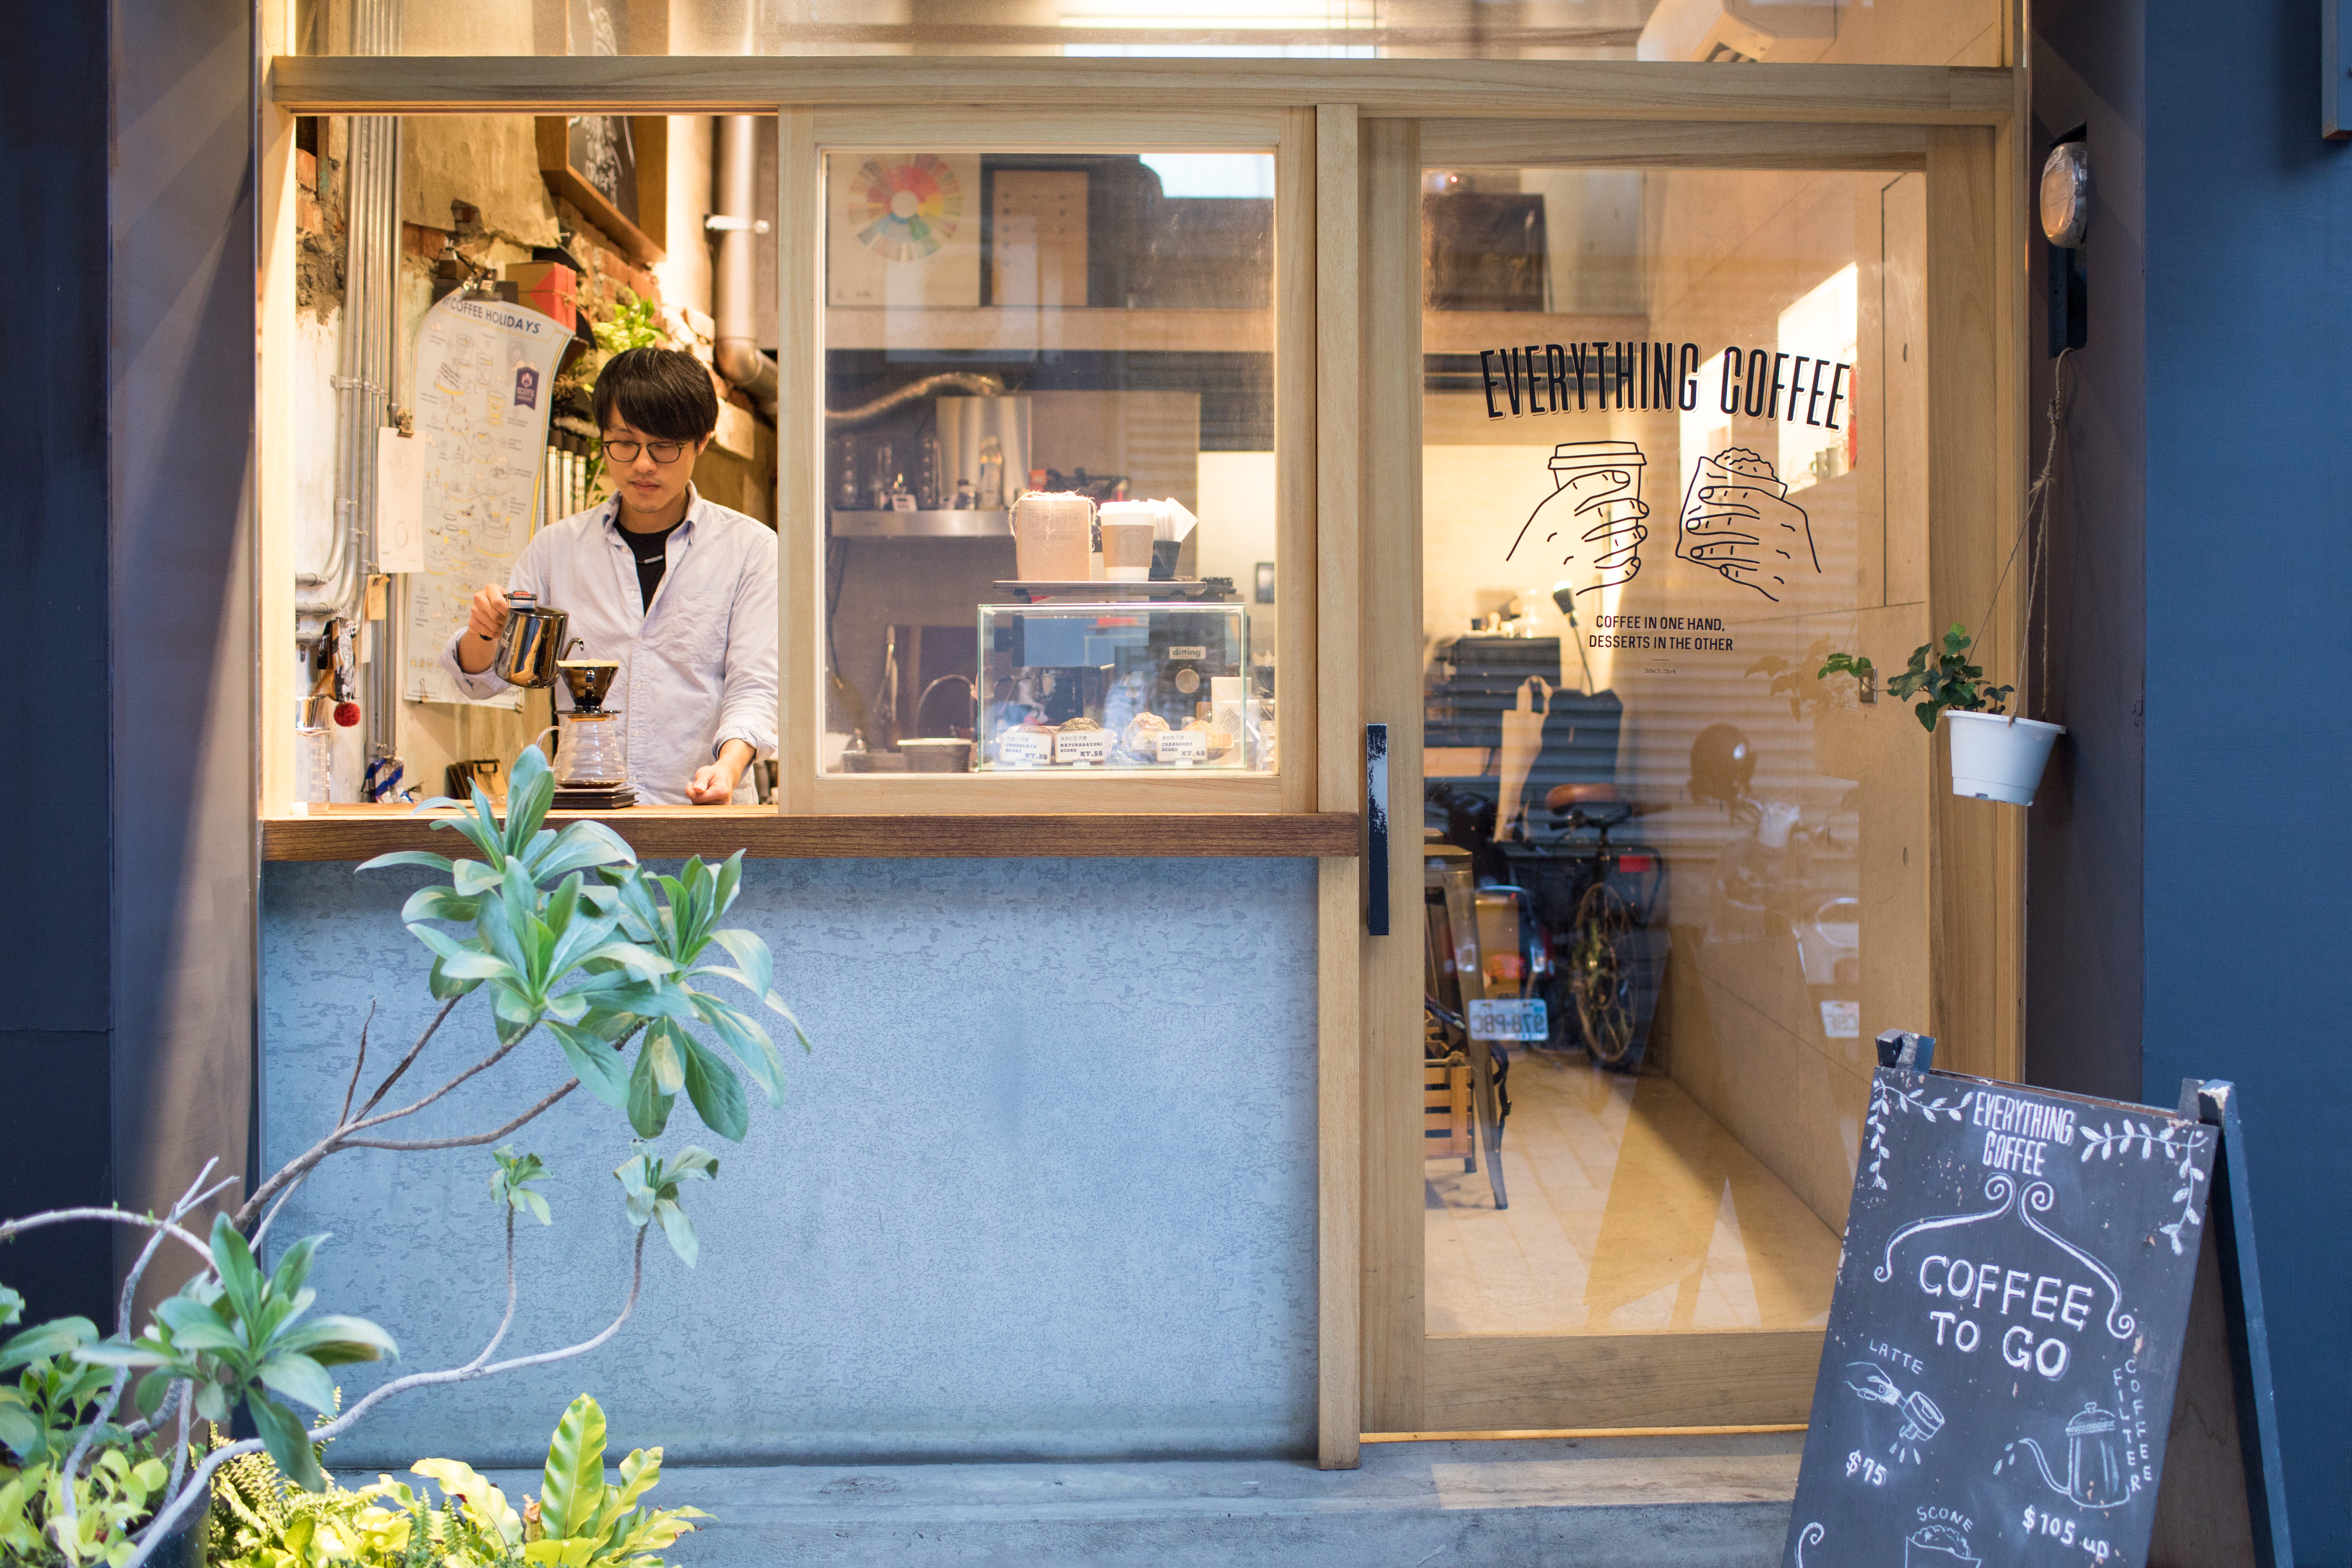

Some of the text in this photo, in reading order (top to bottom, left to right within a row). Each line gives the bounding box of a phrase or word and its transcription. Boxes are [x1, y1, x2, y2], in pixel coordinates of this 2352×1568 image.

[451, 298, 482, 318] COFFEE
[486, 309, 540, 334] HOLIDAYS
[1480, 341, 1853, 433] EVERYTHING COFFEE
[1589, 635, 1733, 651] DESSERTS IN THE OTHER
[1596, 615, 1725, 632] COFFEE IN ONE HAND,
[1173, 648, 1201, 657] ditting
[1973, 1091, 2076, 1146] EVERYTHING
[1982, 1130, 2047, 1177] COFFEE
[1919, 1255, 2095, 1332] COFFEE
[1869, 1339, 1923, 1375] LATTE
[1929, 1311, 2071, 1382] TO GO
[2112, 1367, 2141, 1492] FILTER
[2125, 1359, 2153, 1481] COFFEE
[1846, 1449, 1887, 1487] $75
[1916, 1506, 1974, 1533] SCONE
[2022, 1504, 2076, 1548] $105
